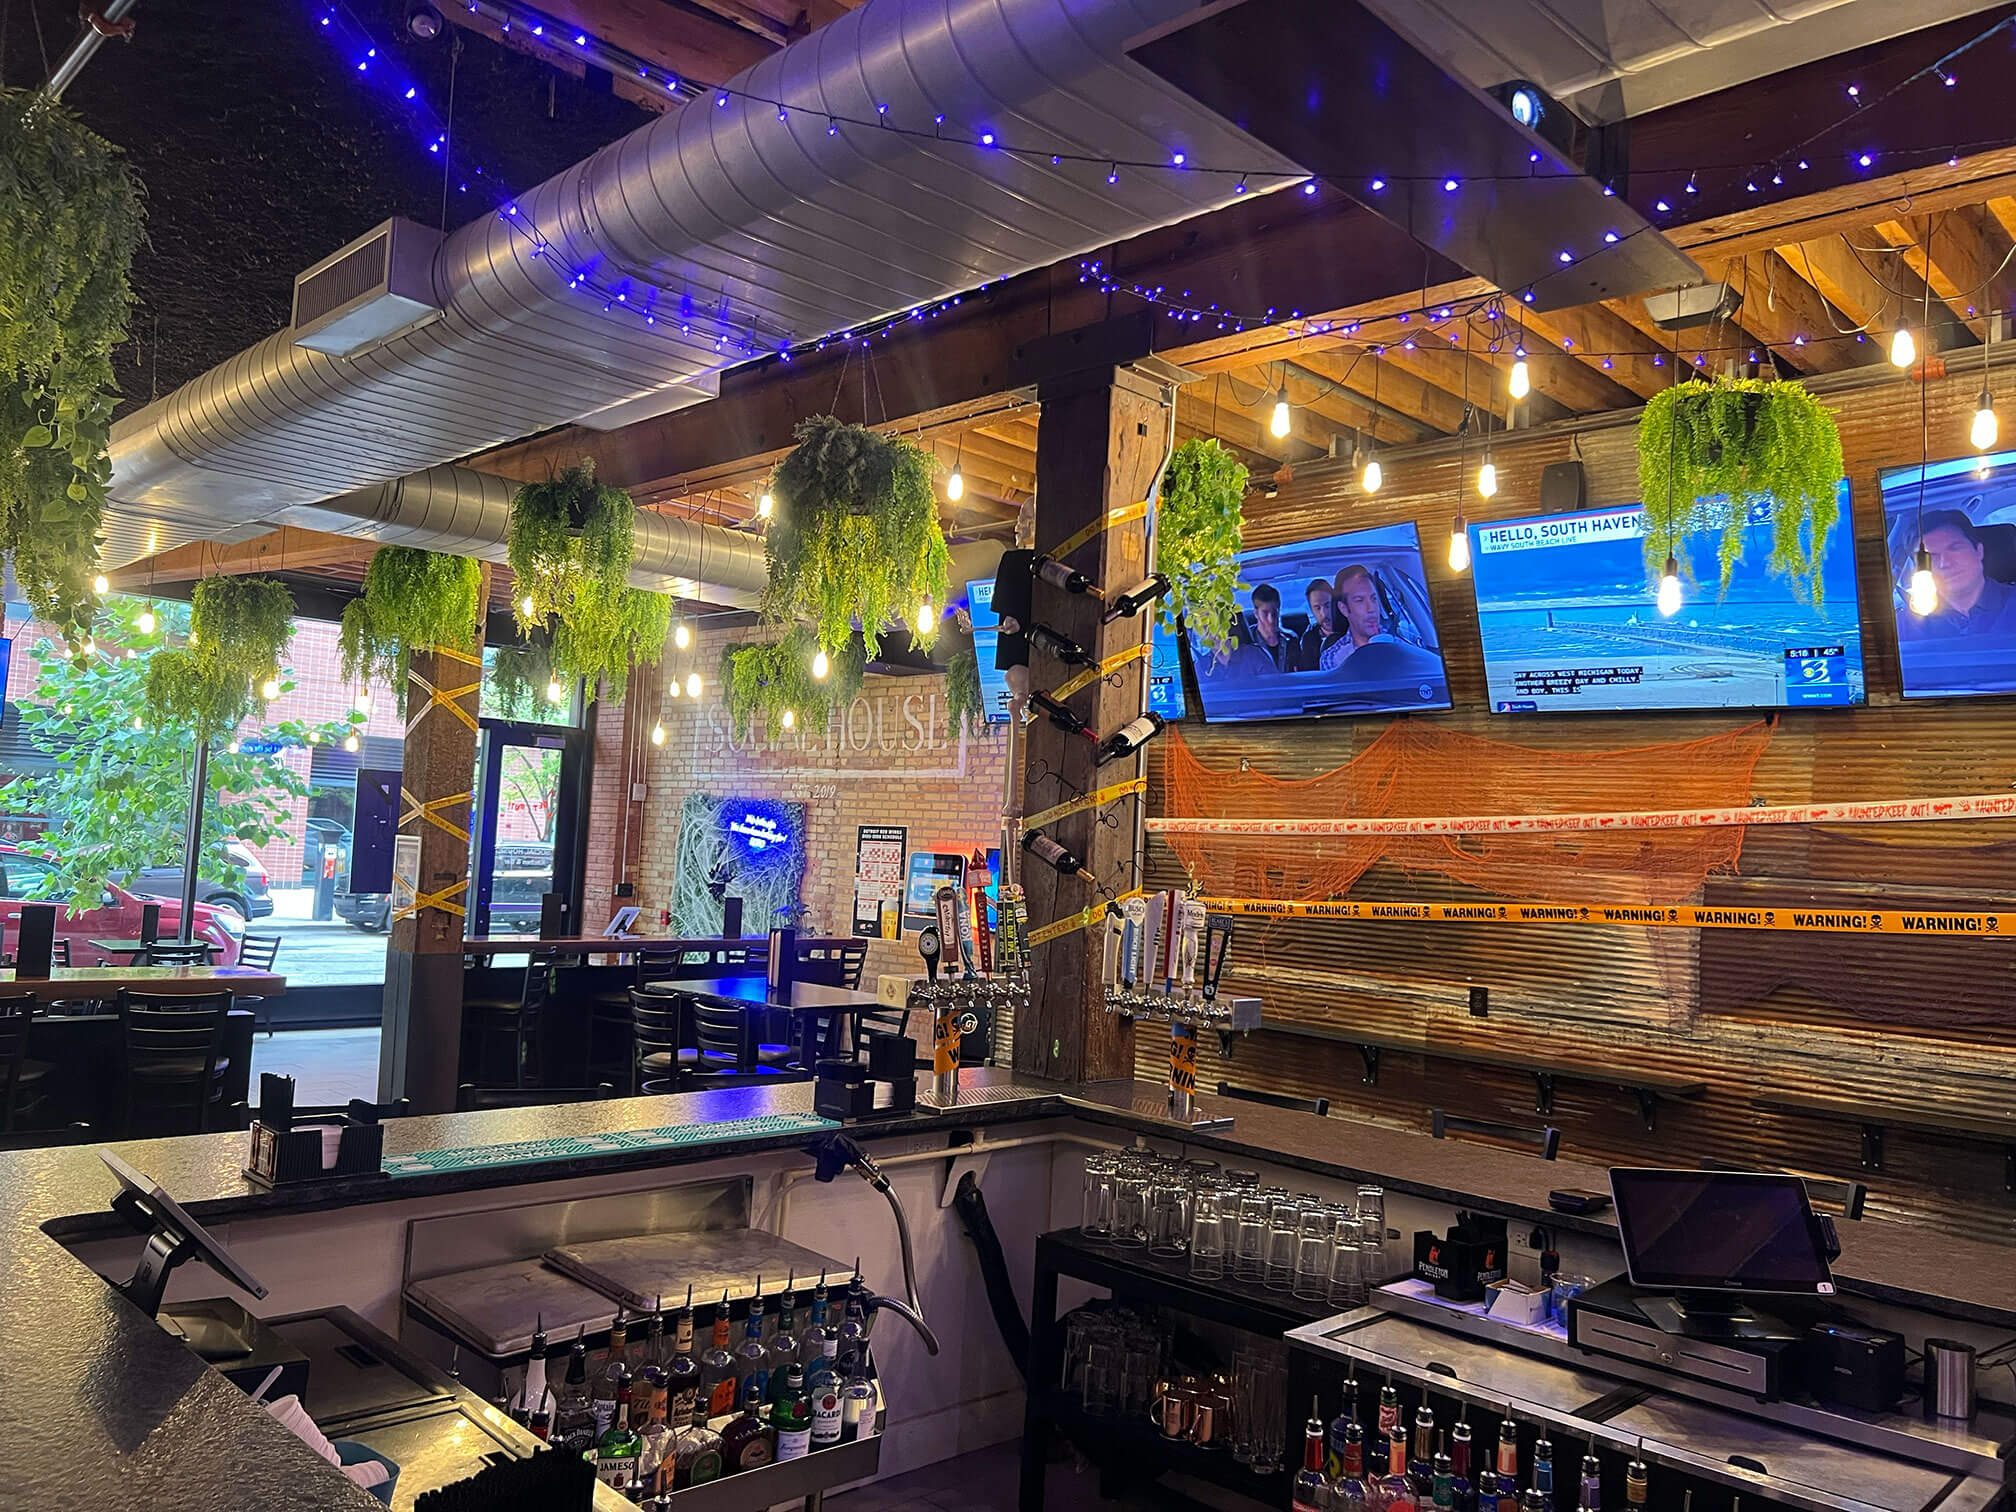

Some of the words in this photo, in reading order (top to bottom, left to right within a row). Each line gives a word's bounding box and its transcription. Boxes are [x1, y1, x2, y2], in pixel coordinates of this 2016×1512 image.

[1490, 527, 1537, 543] HELLO,
[1541, 522, 1587, 538] SOUTH
[1592, 516, 1642, 532] HAVEN
[1511, 542, 1534, 550] SOUTH
[1536, 539, 1560, 547] BEACH
[1561, 536, 1577, 545] LIVE
[827, 694, 948, 752] HOUSE
[813, 784, 836, 799] 2019
[1849, 806, 1884, 818] HAUNTED
[1911, 803, 1930, 817] OUT!
[1975, 798, 2016, 813] HAUNTED
[1792, 810, 1807, 821] OUT!
[1202, 900, 1225, 911] NING!
[1243, 903, 1285, 914] WARNING!
[1305, 904, 1351, 916] WARNING!
[1371, 906, 1421, 917] WARNING!
[1443, 907, 1496, 918] WARNING!
[1520, 908, 1577, 919] WARNING!
[1603, 909, 1665, 922] WARNING!
[1694, 911, 1761, 925] WARNING!
[1793, 914, 1867, 929] WARNING!
[1901, 916, 1982, 931] WARNING!
[959, 910, 972, 942] KONA
[1419, 1261, 1449, 1279] PENDLETON
[600, 1461, 635, 1471] JAMESO
